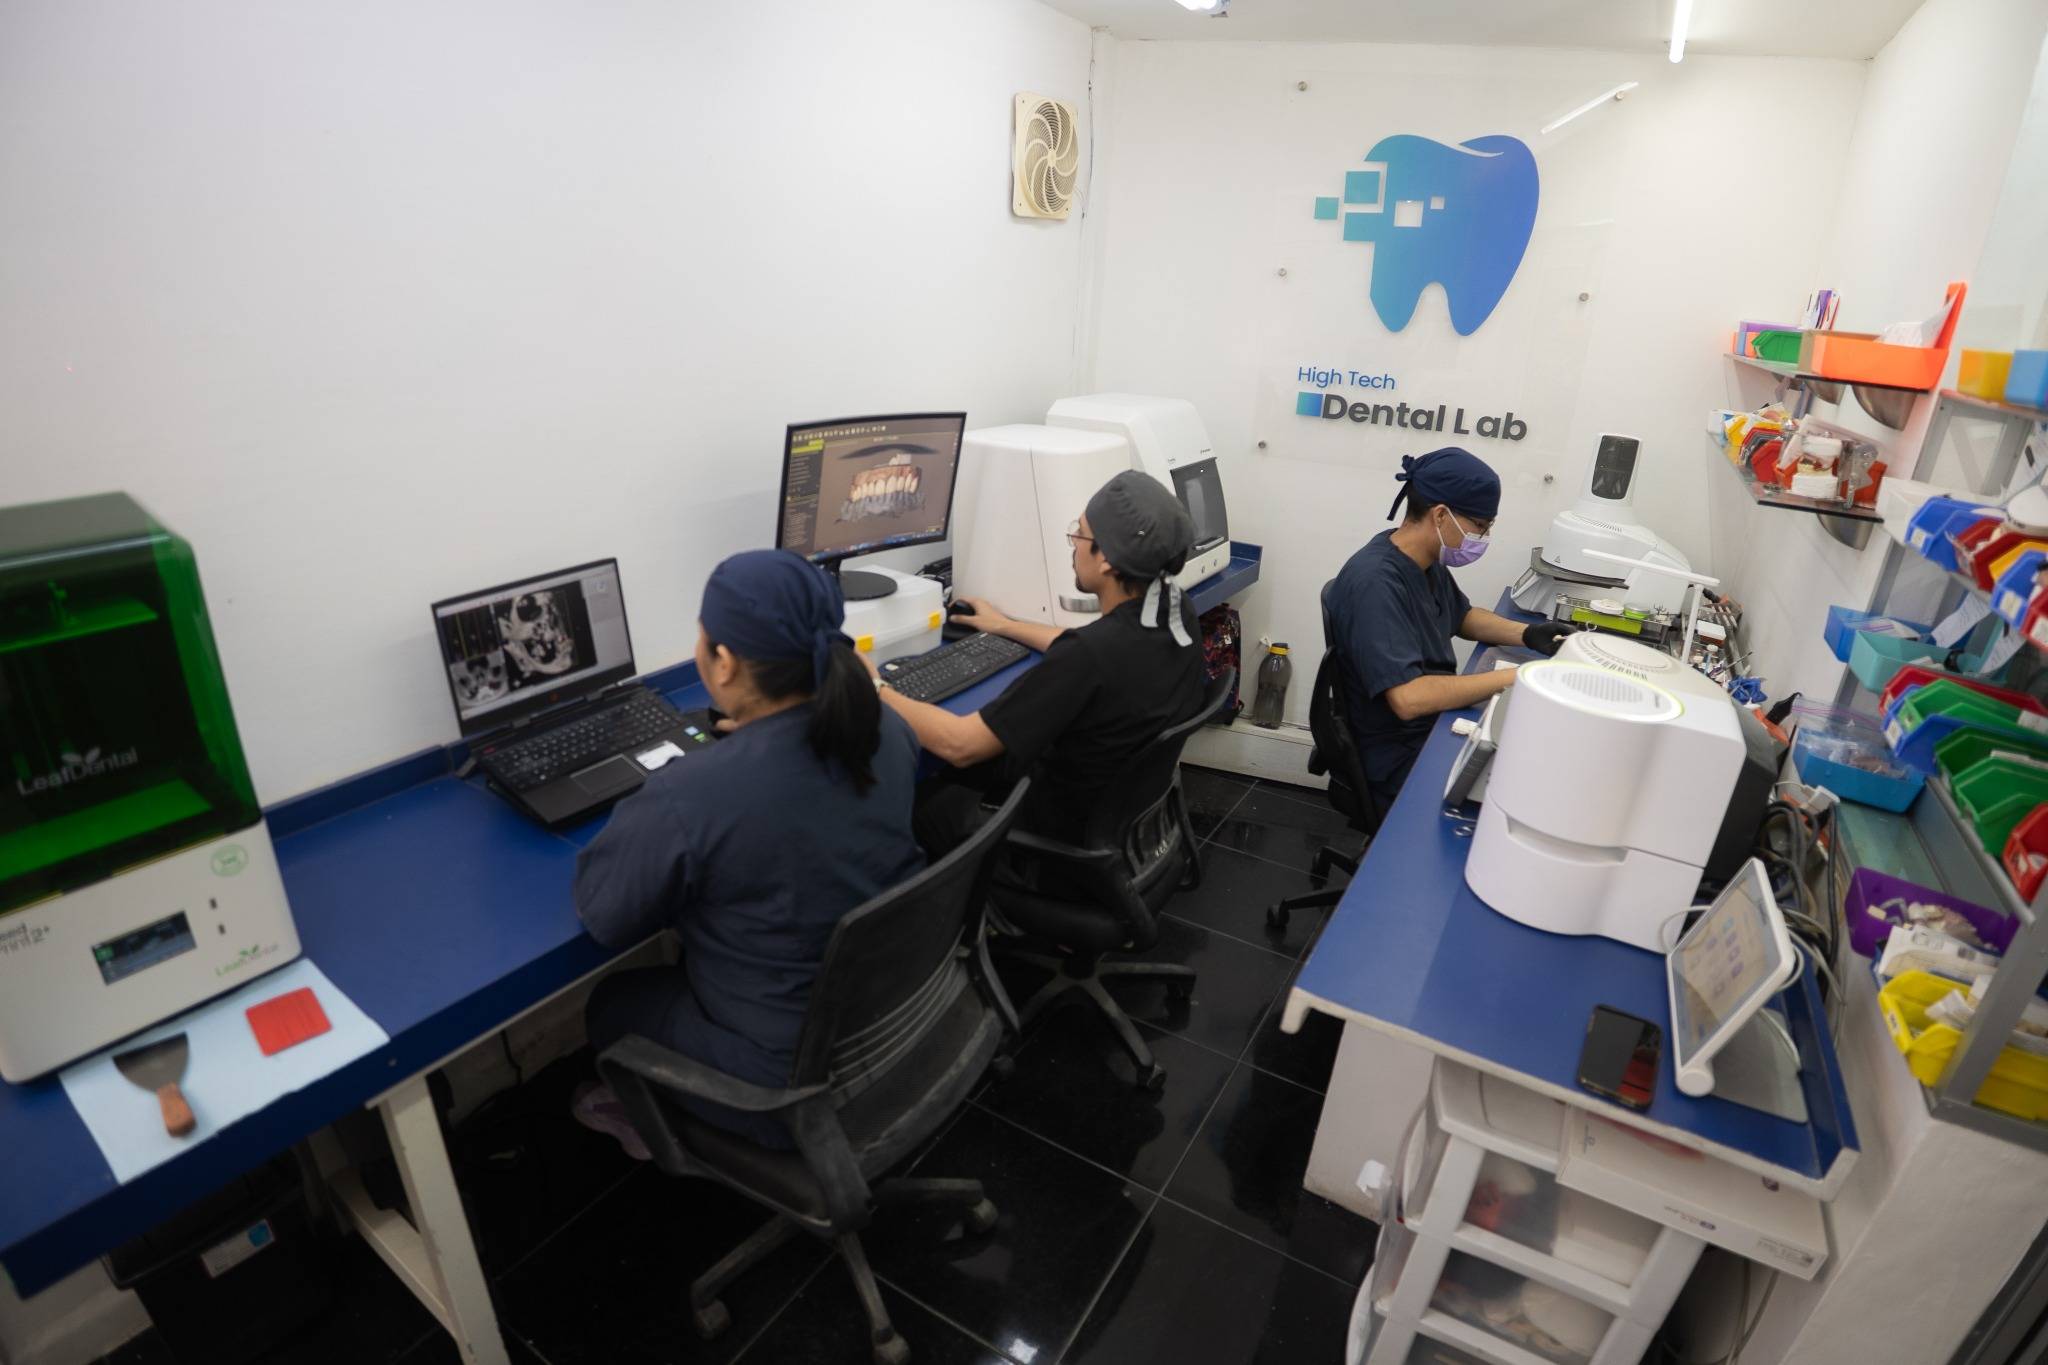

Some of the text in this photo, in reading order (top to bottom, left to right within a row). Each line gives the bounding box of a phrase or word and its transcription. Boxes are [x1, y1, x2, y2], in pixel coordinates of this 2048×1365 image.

[1298, 366, 1396, 390] High Tech
[1322, 393, 1447, 432] Dental
